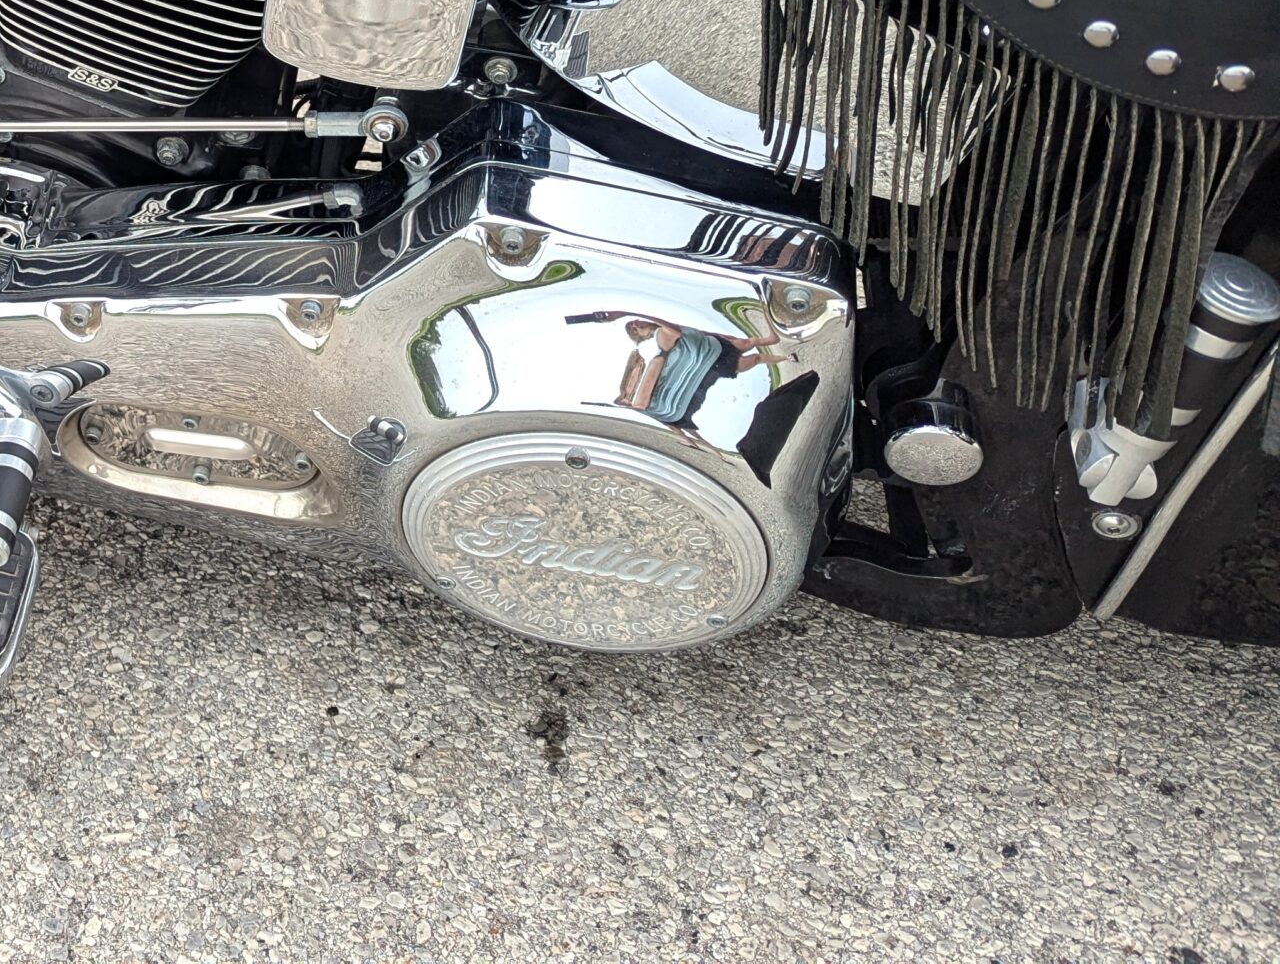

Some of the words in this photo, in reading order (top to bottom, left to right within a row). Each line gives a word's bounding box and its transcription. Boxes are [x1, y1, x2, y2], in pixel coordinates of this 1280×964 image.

[72, 68, 116, 90] S&S
[454, 474, 527, 514] INDIAN
[532, 473, 689, 527] MOTORCYCLE
[455, 515, 705, 591] Indian
[453, 565, 517, 613] INDIAN
[521, 610, 672, 637] MOTORCYCLE
